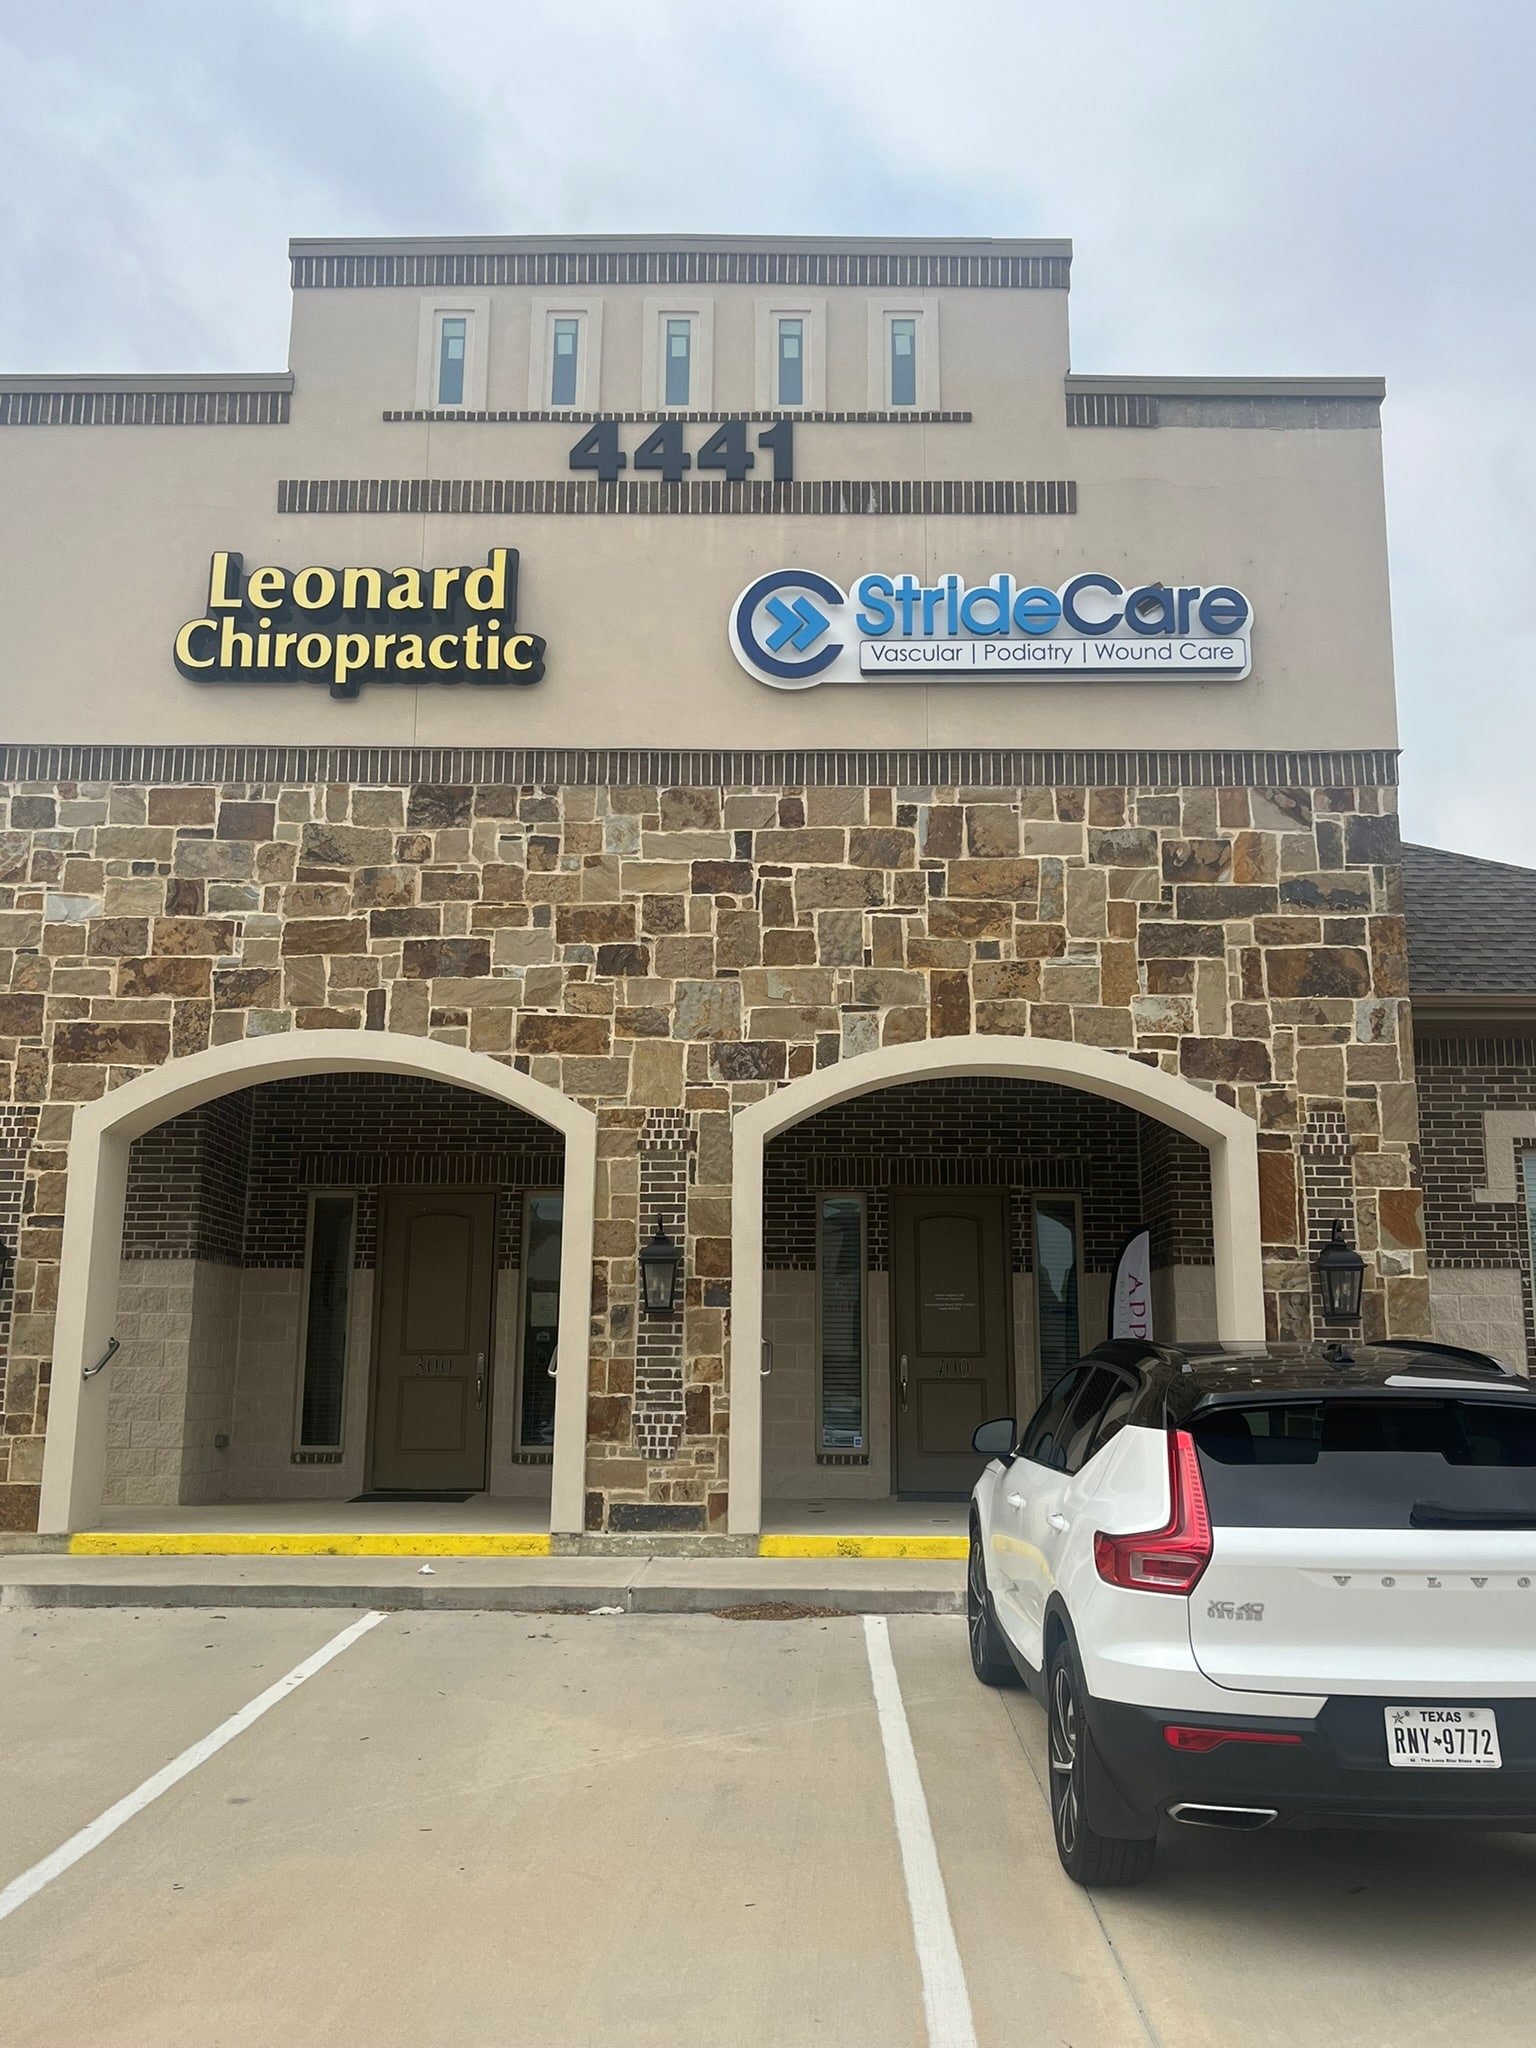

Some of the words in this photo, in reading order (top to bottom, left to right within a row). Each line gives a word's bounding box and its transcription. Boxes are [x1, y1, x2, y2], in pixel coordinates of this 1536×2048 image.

[569, 420, 794, 482] 4441
[209, 548, 507, 610] Leonard
[856, 573, 1248, 635] StrideCare
[176, 616, 535, 683] Chiropractic
[870, 643, 963, 662] Vascular
[983, 642, 1073, 664] Podiatry
[1094, 642, 1173, 661] Wound
[1179, 643, 1234, 661] Care
[1333, 1575, 1532, 1589] VOLVO
[1419, 1711, 1462, 1723] TEXAS
